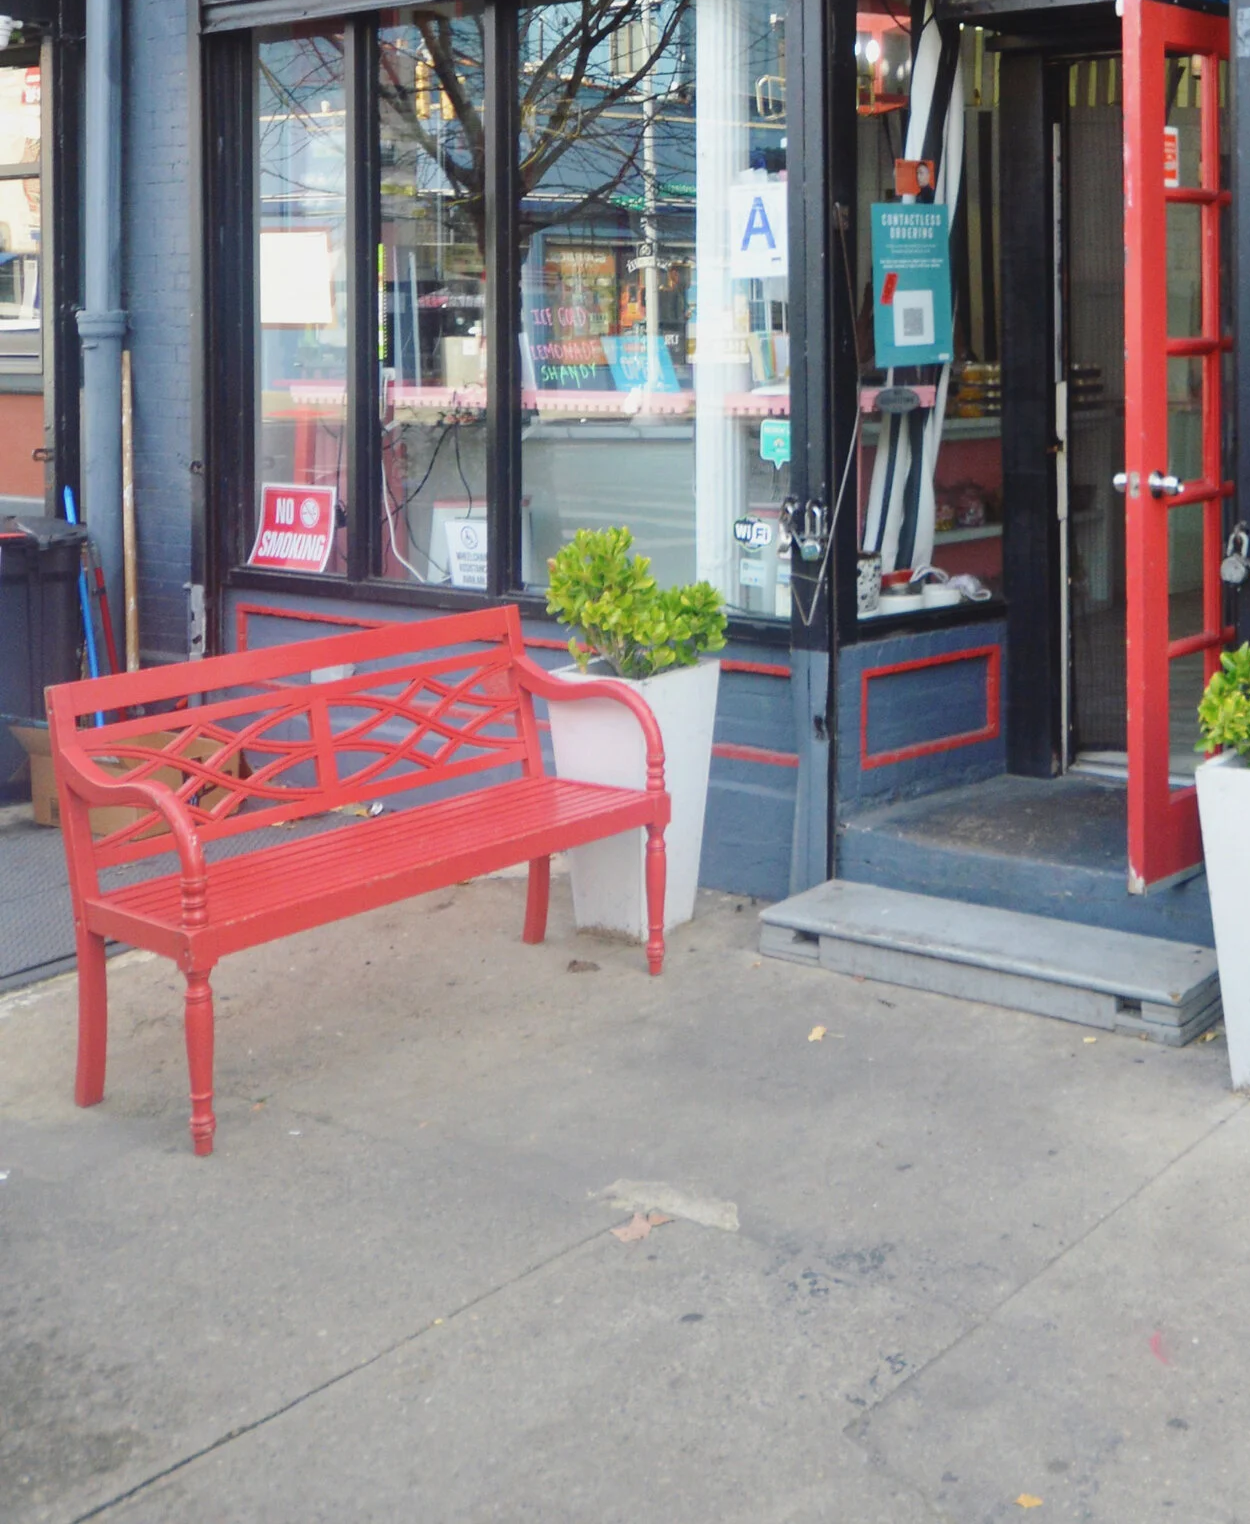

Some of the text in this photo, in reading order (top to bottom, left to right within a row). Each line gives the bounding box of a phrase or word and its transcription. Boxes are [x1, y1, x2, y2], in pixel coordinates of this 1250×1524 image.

[740, 196, 776, 250] A
[881, 214, 941, 226] CONTACTLESS
[890, 227, 933, 239] ORDERING
[541, 362, 596, 389] SHANDY
[275, 497, 294, 525] NO
[258, 530, 326, 561] SMOKING
